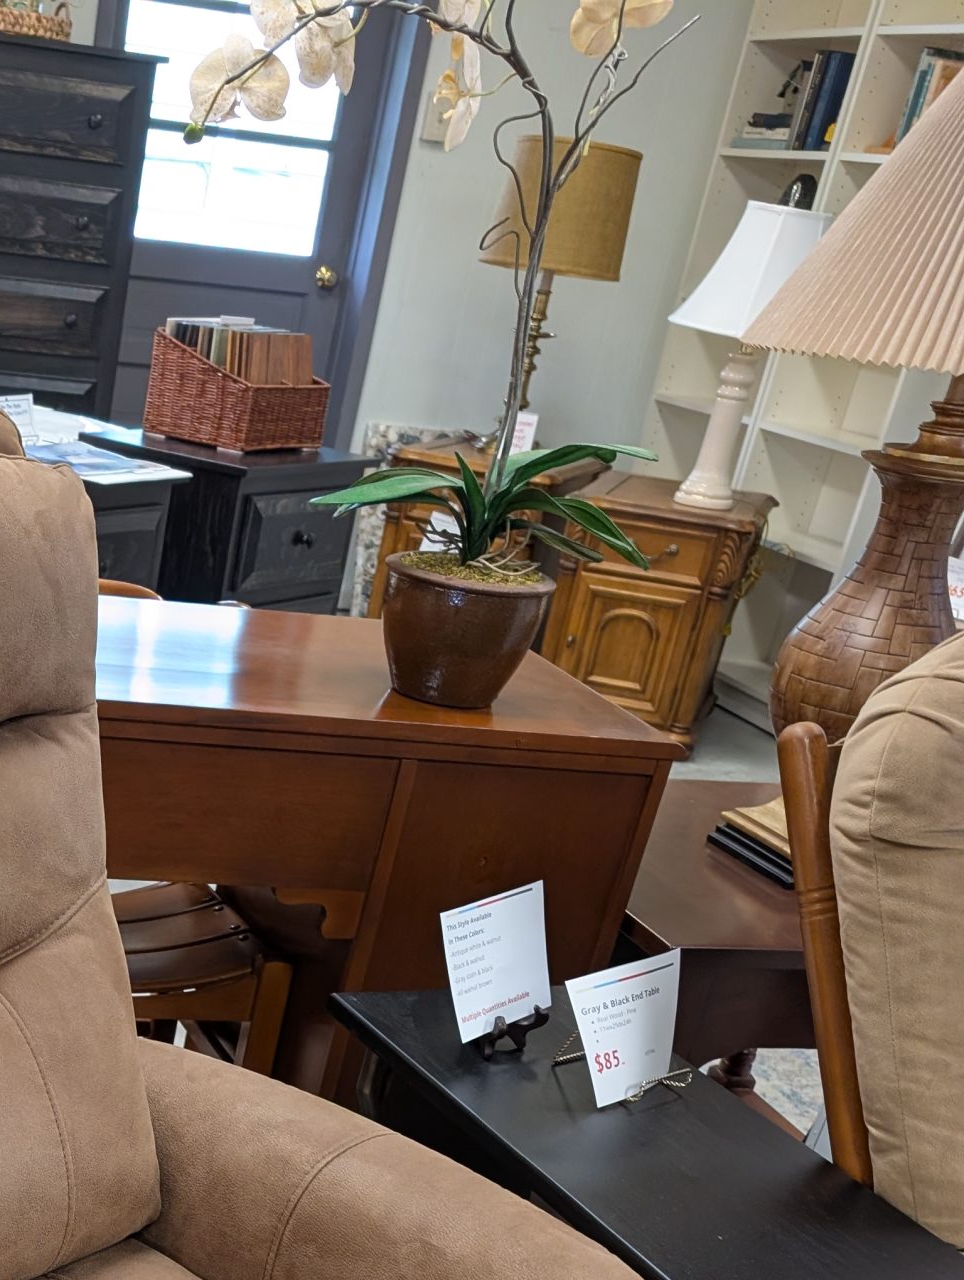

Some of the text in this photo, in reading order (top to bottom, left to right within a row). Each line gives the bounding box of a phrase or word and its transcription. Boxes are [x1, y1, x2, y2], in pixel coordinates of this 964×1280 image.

[457, 922, 469, 930] Style
[470, 912, 492, 925] Available
[454, 935, 468, 944] These
[468, 929, 485, 939] Colors:
[469, 944, 481, 952] white
[487, 936, 501, 945] walnut
[470, 955, 485, 964] walnut
[481, 966, 493, 974] black
[478, 980, 493, 989] brown
[461, 992, 530, 1023] Multiple Quantities Available
[581, 986, 660, 1015] Gray & Black End Table
